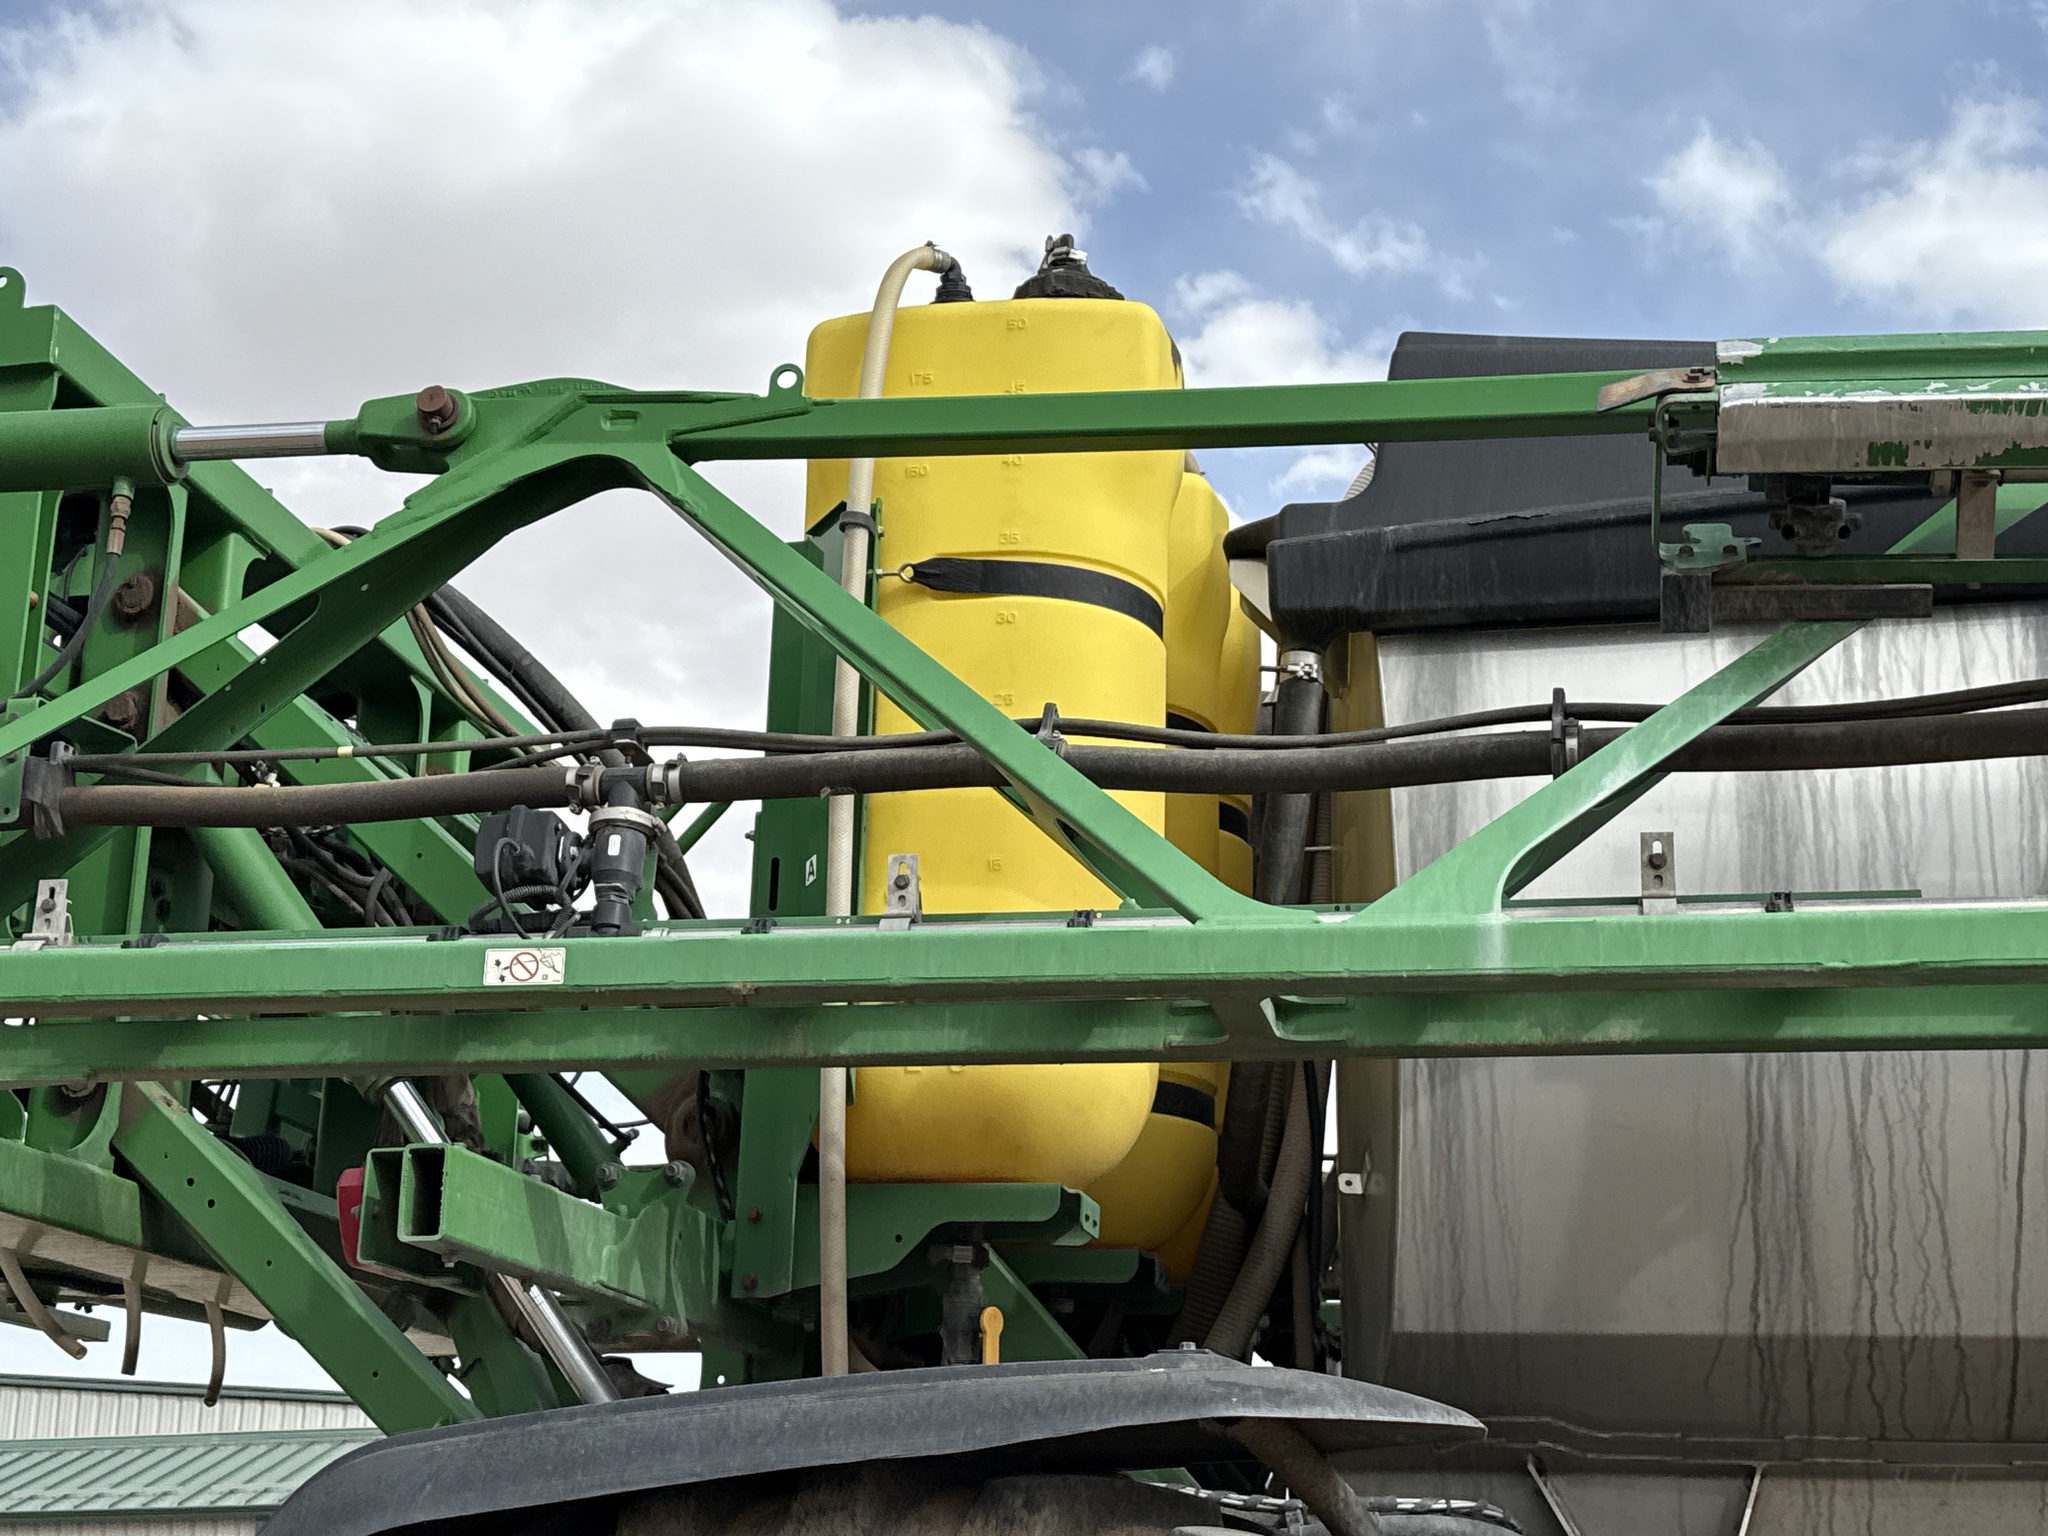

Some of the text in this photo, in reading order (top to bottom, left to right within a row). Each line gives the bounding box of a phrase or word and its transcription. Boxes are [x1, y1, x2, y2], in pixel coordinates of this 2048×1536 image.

[1006, 317, 1027, 331] 50
[909, 371, 933, 386] 175
[904, 463, 929, 478] 150
[999, 530, 1020, 545] 35
[996, 609, 1017, 625] 30
[987, 855, 1003, 872] 15
